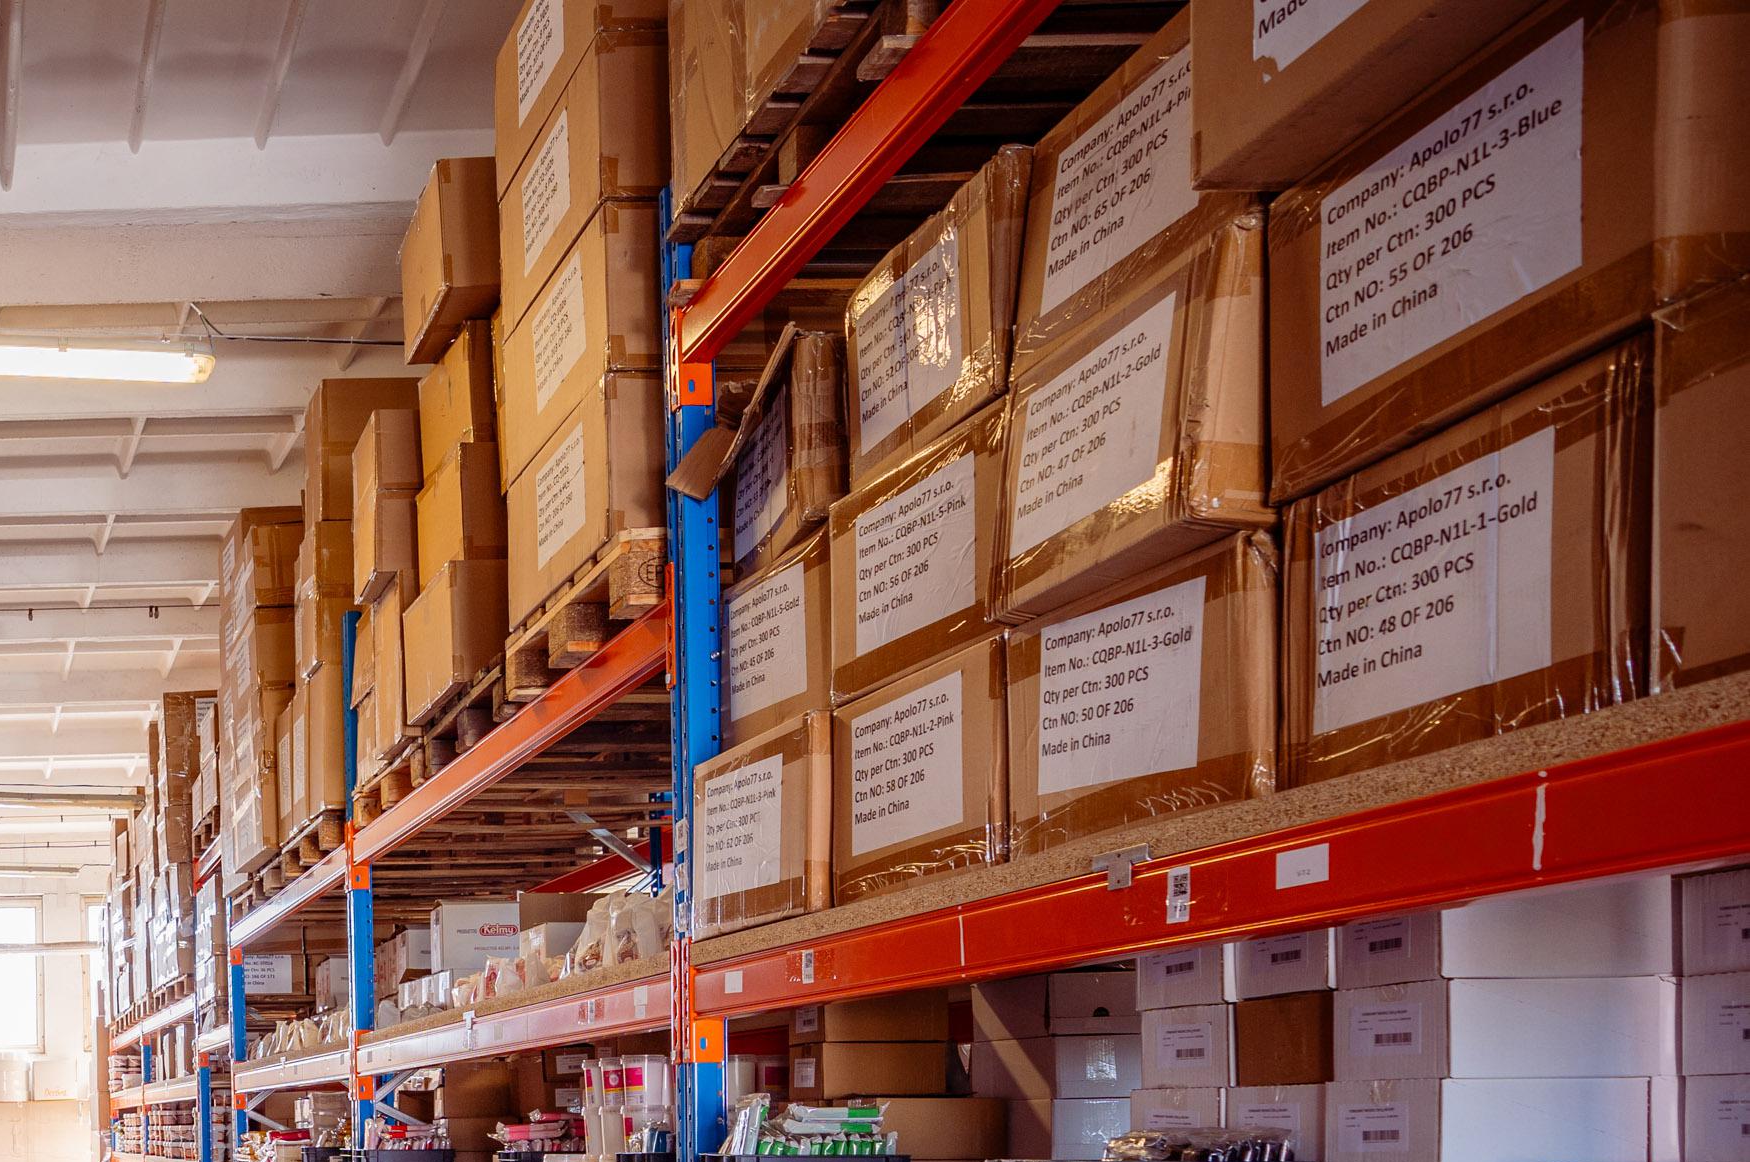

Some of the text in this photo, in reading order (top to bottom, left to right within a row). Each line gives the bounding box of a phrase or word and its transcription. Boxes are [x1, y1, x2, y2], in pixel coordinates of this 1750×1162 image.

[1327, 83, 1534, 225] Company: Apolo77 s.r.o.
[1326, 99, 1562, 259] Item No.: CQBP-N1L-3-Blue
[1325, 172, 1495, 290] Qty per Ctn: 300 PCS
[1325, 222, 1473, 323] Ctn NO: 55 OF 206
[1325, 282, 1438, 357] Made in China
[854, 693, 949, 738] Company: Apolo77 s.r.o.
[854, 746, 871, 759] Item
[872, 740, 887, 753] No.:
[854, 741, 934, 782] Qty per Ctn: 300 PCS
[854, 768, 924, 803] Ctn NO: 58 OF 206
[854, 799, 909, 825] Made in China
[483, 923, 514, 936] Kelmy
